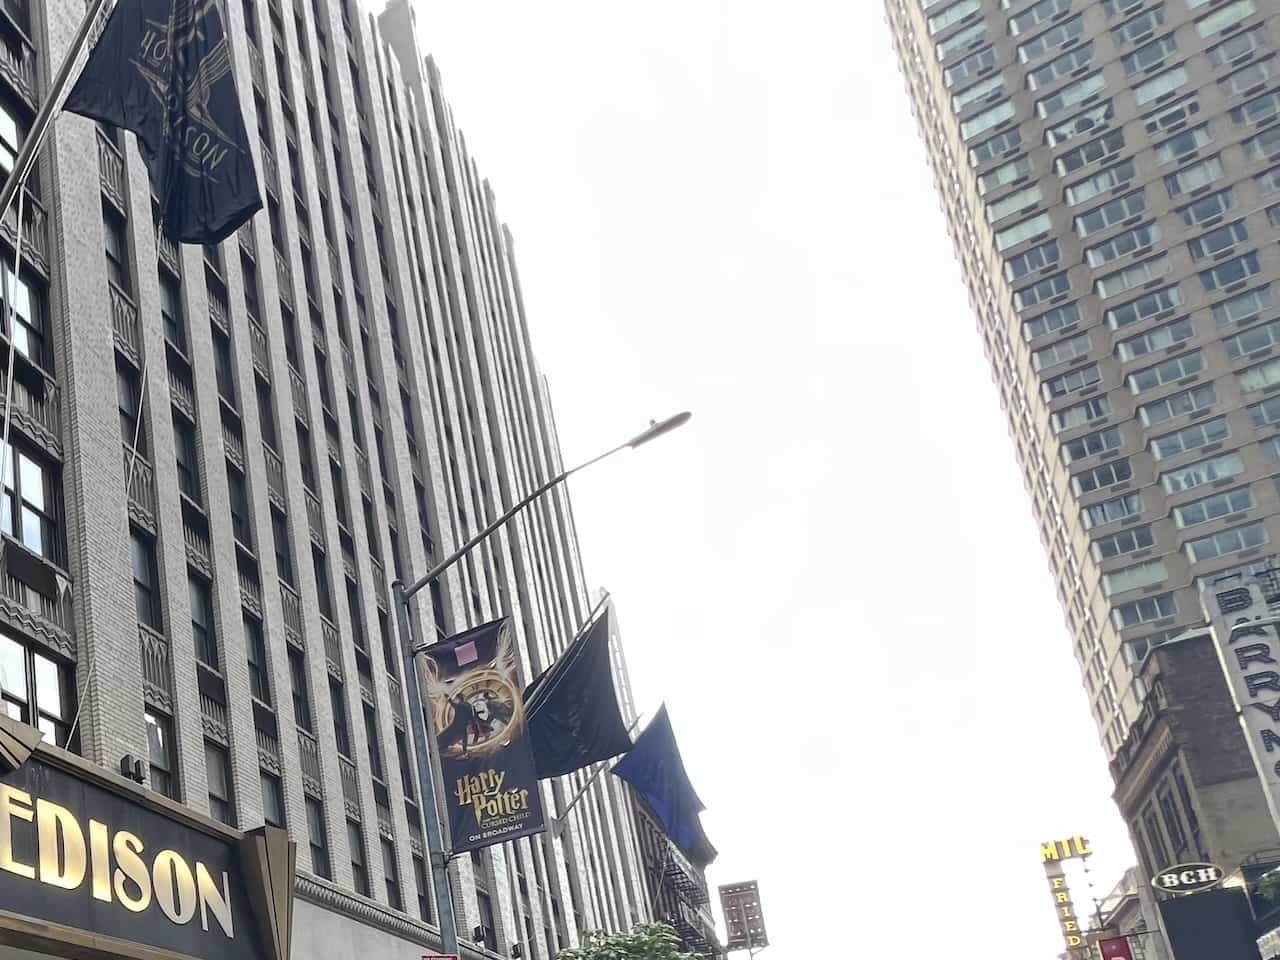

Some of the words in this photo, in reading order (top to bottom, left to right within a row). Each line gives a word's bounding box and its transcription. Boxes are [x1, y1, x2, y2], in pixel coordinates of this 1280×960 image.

[454, 768, 505, 805] Harry
[472, 788, 529, 828] Potter
[1160, 867, 1217, 887] BCH
